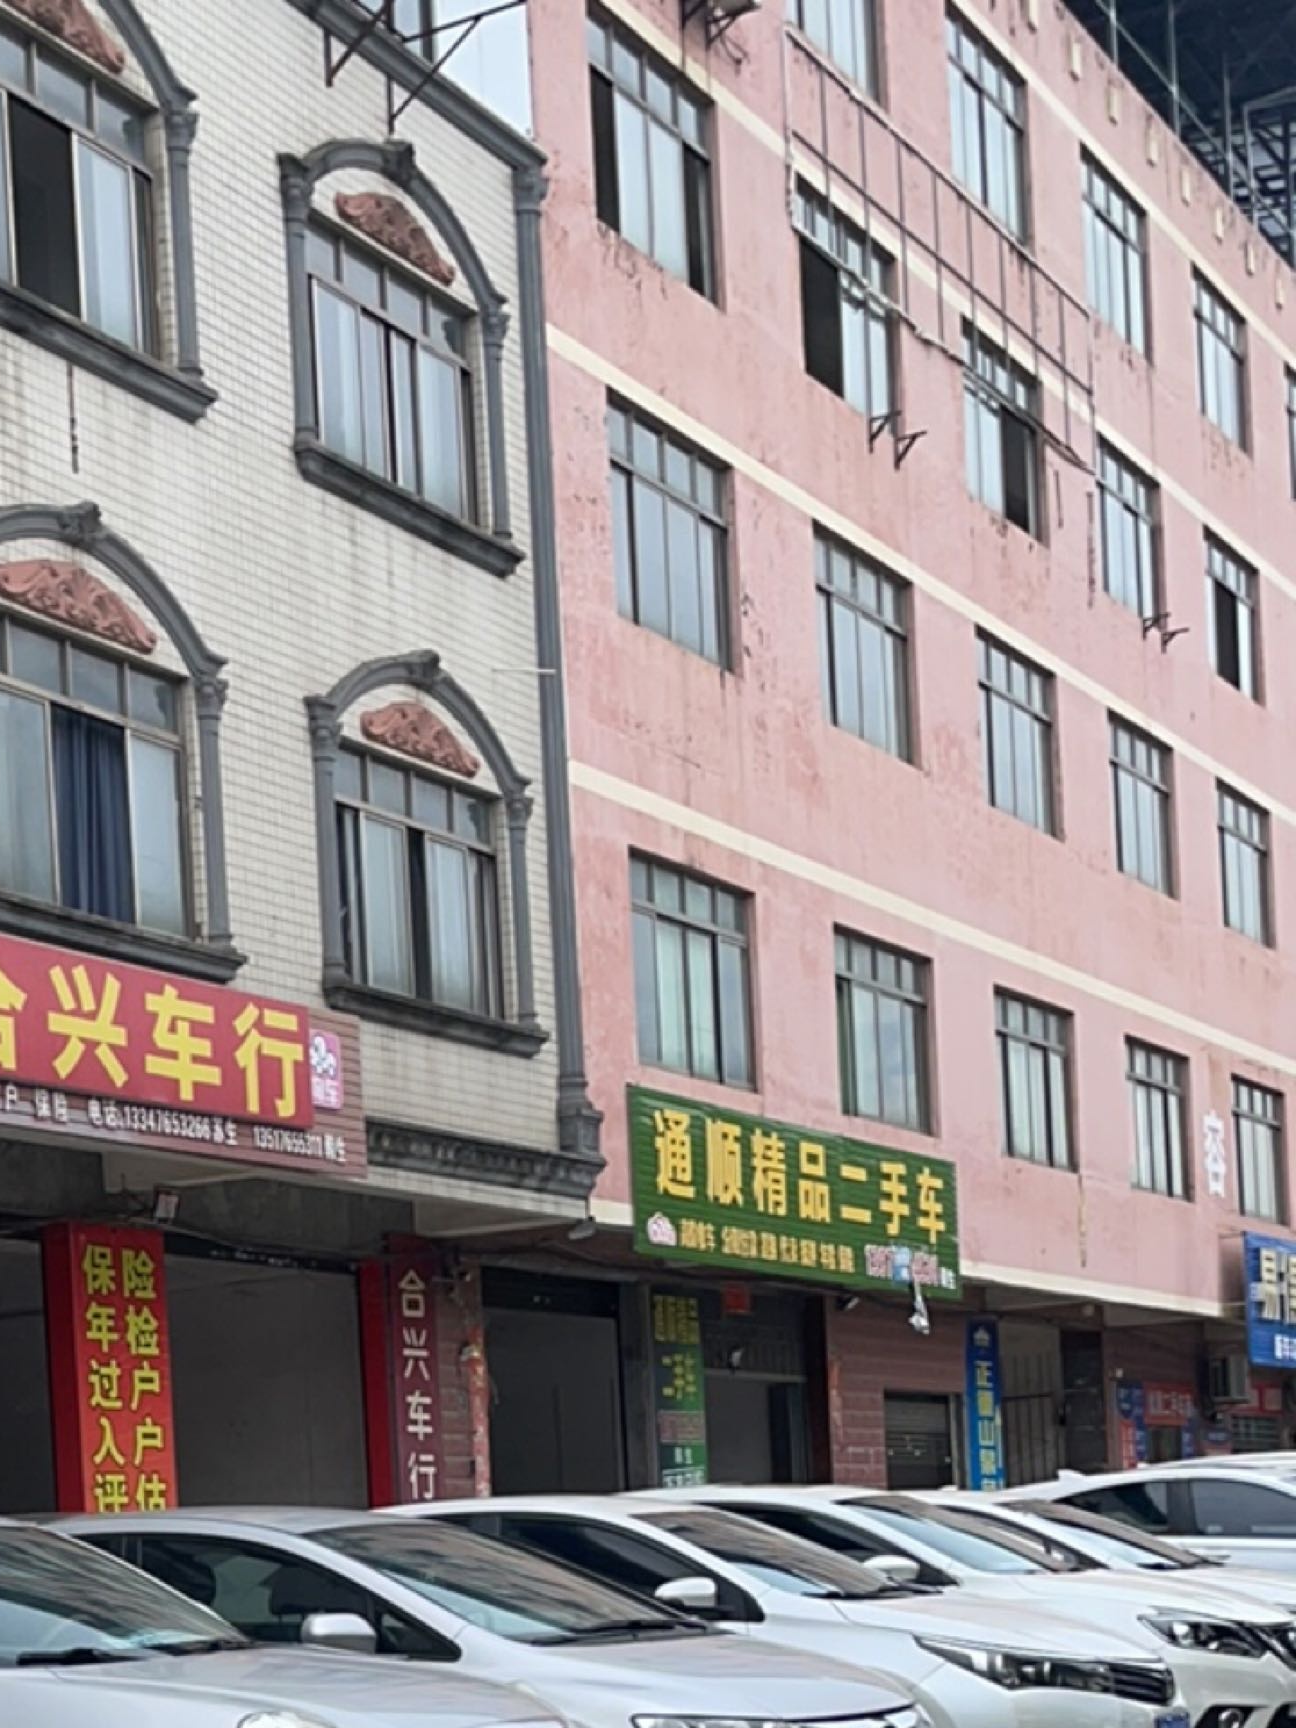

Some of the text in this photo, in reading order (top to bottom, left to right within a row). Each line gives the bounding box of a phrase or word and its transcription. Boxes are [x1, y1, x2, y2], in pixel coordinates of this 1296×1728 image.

[654, 1108, 947, 1244] 通顺精品二手车
[398, 1269, 437, 1500] 合兴车行
